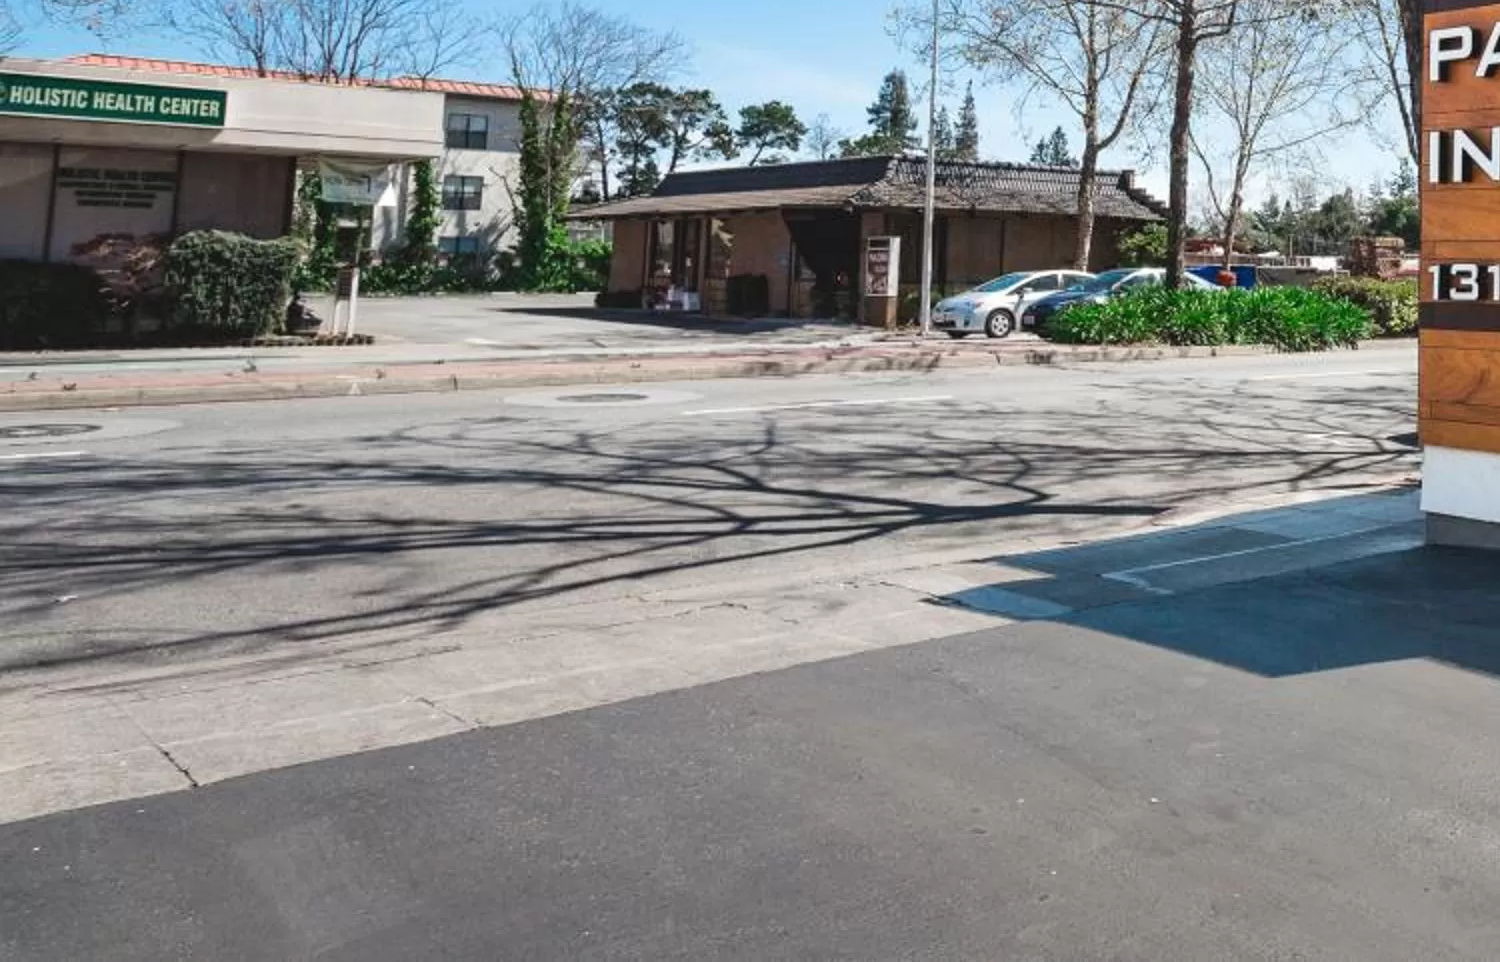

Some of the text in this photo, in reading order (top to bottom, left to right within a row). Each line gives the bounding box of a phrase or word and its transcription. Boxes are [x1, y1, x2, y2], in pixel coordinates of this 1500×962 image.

[9, 85, 220, 117] HOLISTIC HEALTH CENTER
